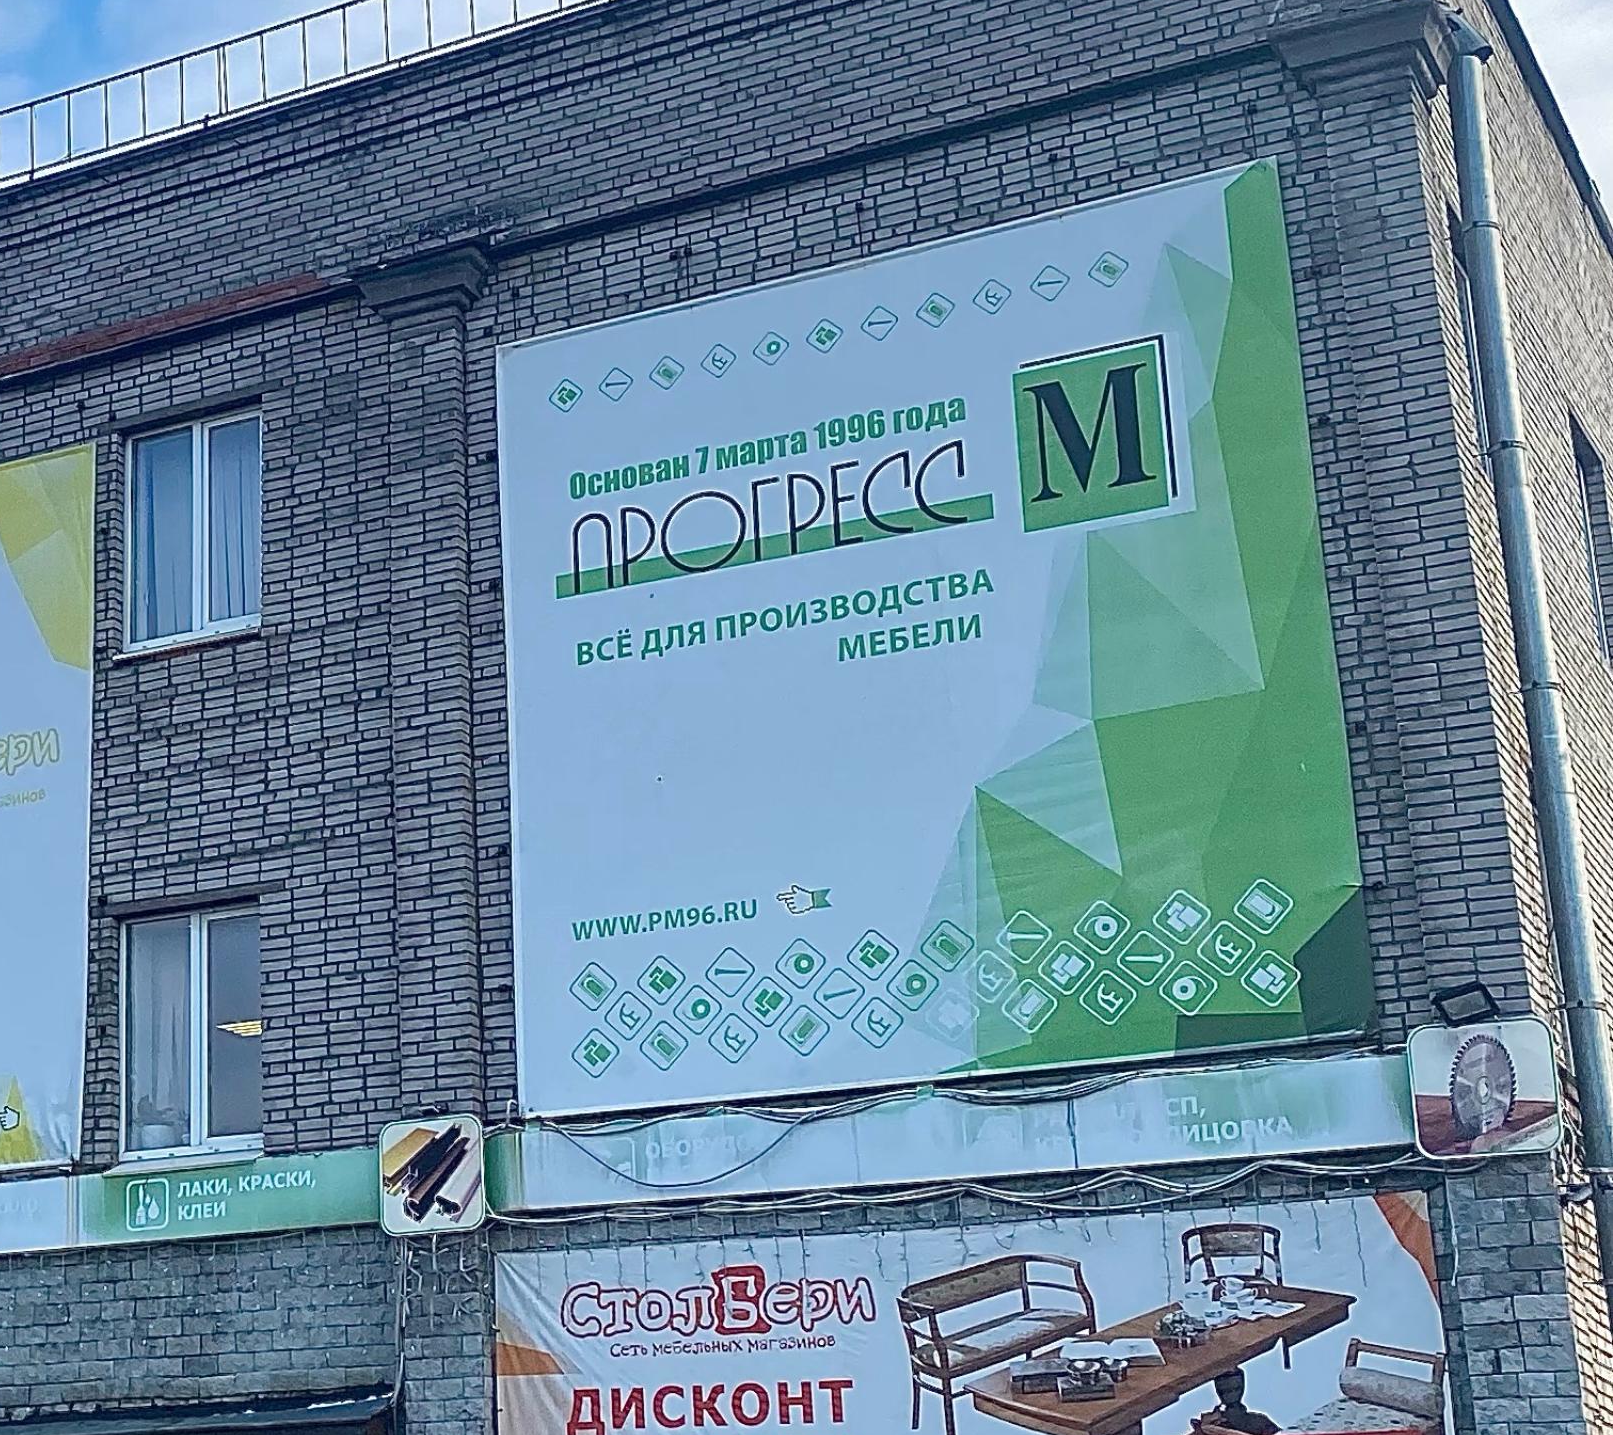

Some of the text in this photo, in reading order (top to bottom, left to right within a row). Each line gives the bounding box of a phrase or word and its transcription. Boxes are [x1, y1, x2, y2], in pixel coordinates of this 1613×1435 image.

[570, 397, 965, 499] Основан 7 марта 1996 года
[573, 439, 969, 595] ПРОГРЕСС
[577, 569, 994, 665] ВСЁ ДЛЯ ПРОИЗВОДСТВА
[838, 613, 982, 662] МЕБЕЛИ
[572, 899, 758, 941] WWW.PM96.RU
[177, 1170, 316, 1198] ЛАКИ, КРАСКИ,
[177, 1201, 226, 1221] КЛЕИ
[610, 1342, 648, 1358] Сеть
